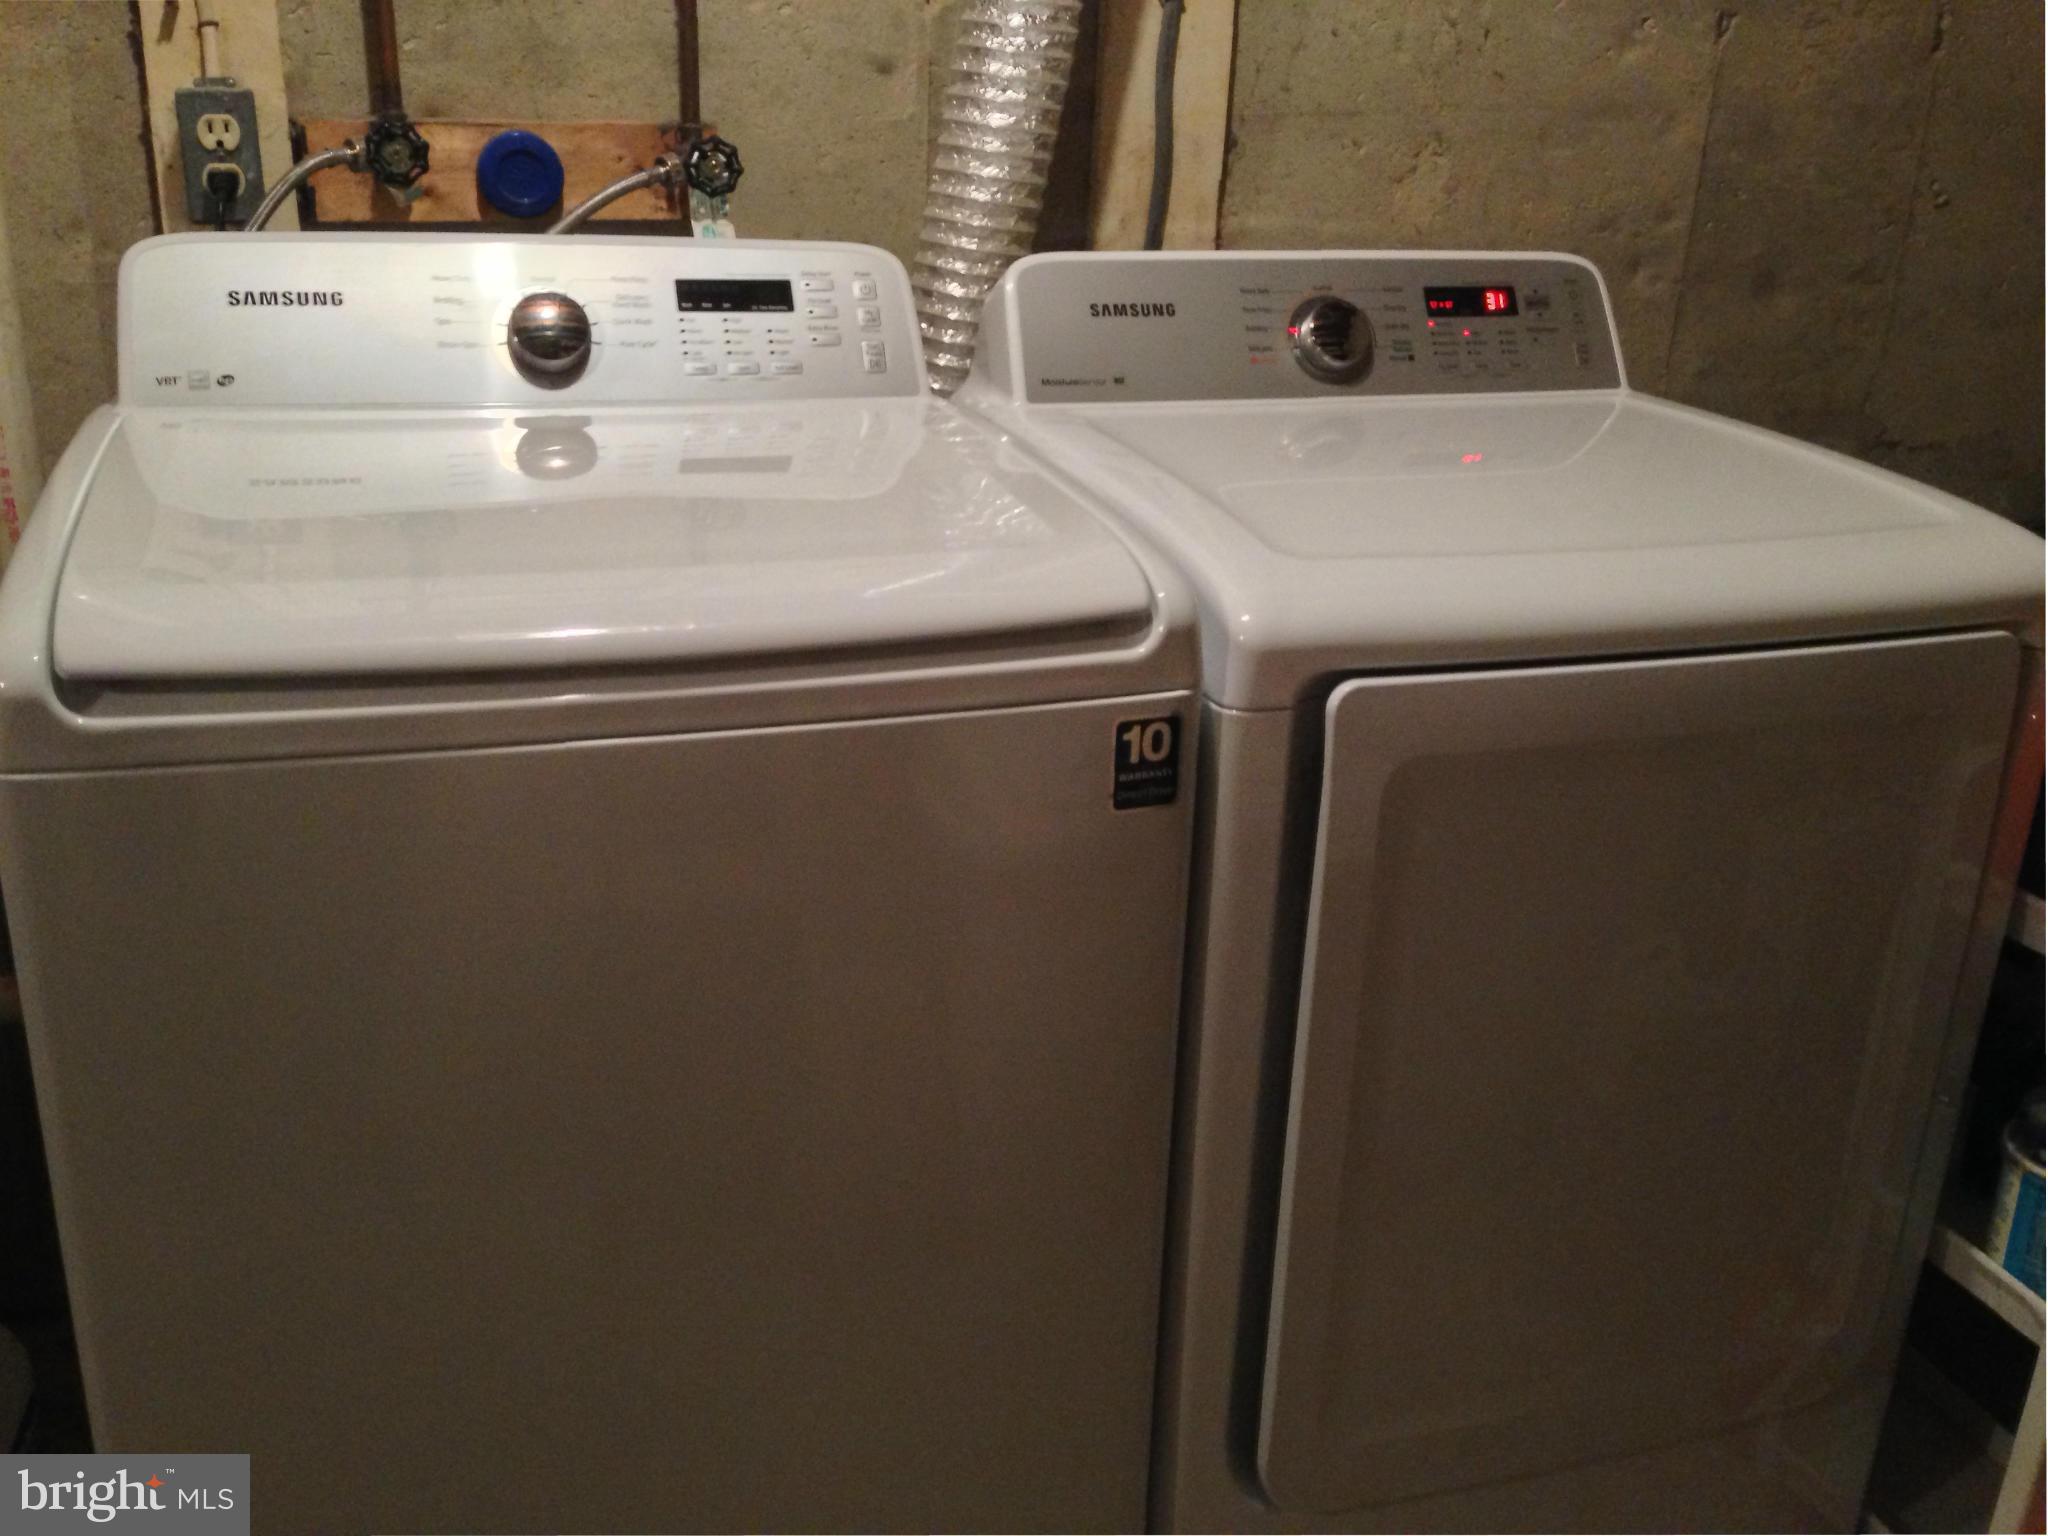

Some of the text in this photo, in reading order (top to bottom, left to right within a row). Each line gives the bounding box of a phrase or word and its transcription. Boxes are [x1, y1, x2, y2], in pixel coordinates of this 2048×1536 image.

[227, 290, 344, 307] SAMSUNG
[1089, 302, 1176, 318] SAMSUNG
[1122, 721, 1172, 764] 10
